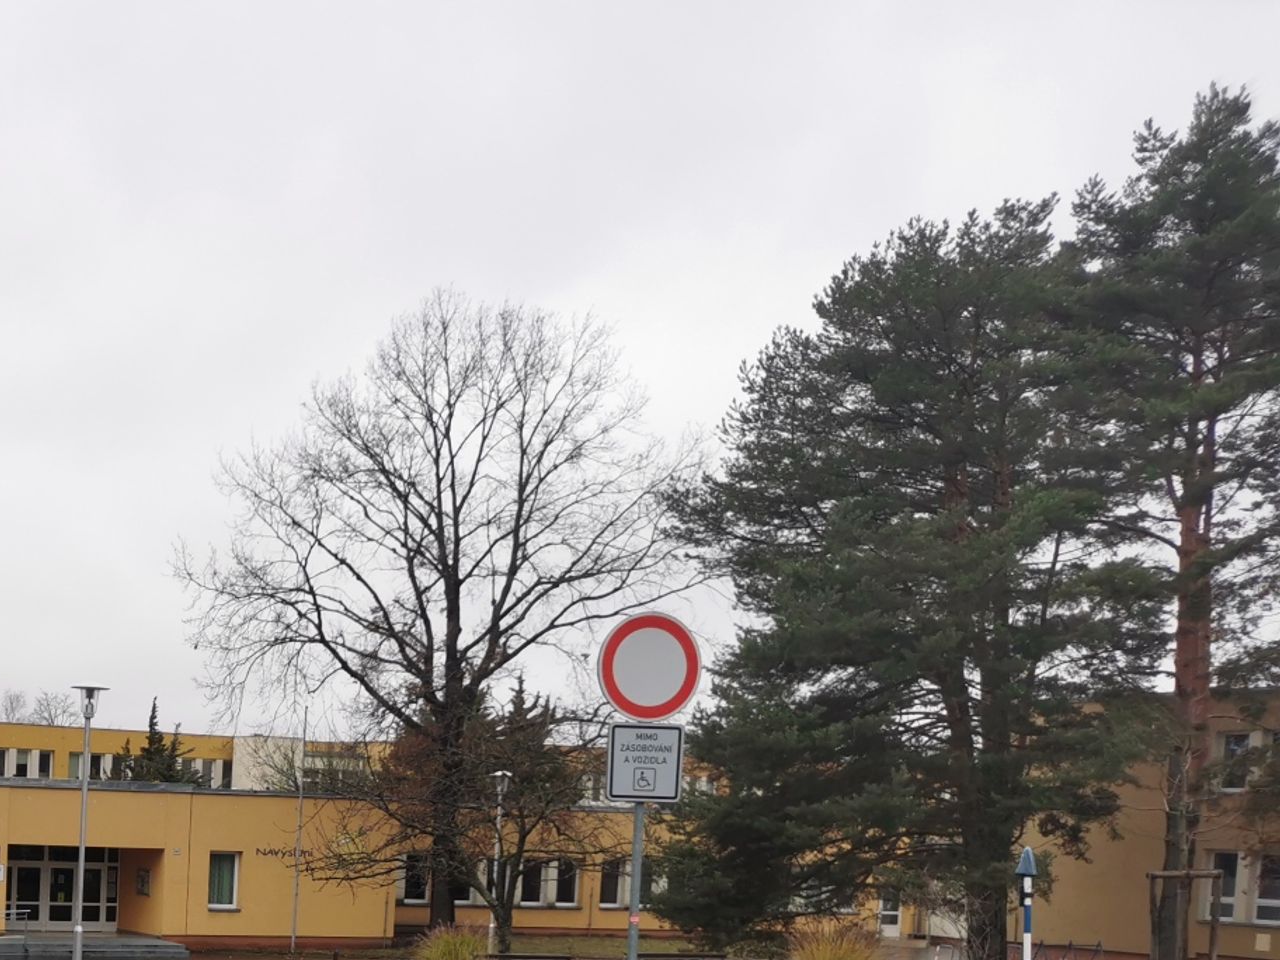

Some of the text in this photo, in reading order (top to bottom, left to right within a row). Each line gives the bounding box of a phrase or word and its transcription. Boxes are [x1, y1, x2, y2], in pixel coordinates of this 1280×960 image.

[635, 732, 658, 741] MIMO
[624, 755, 668, 765] A VOZIDLA
